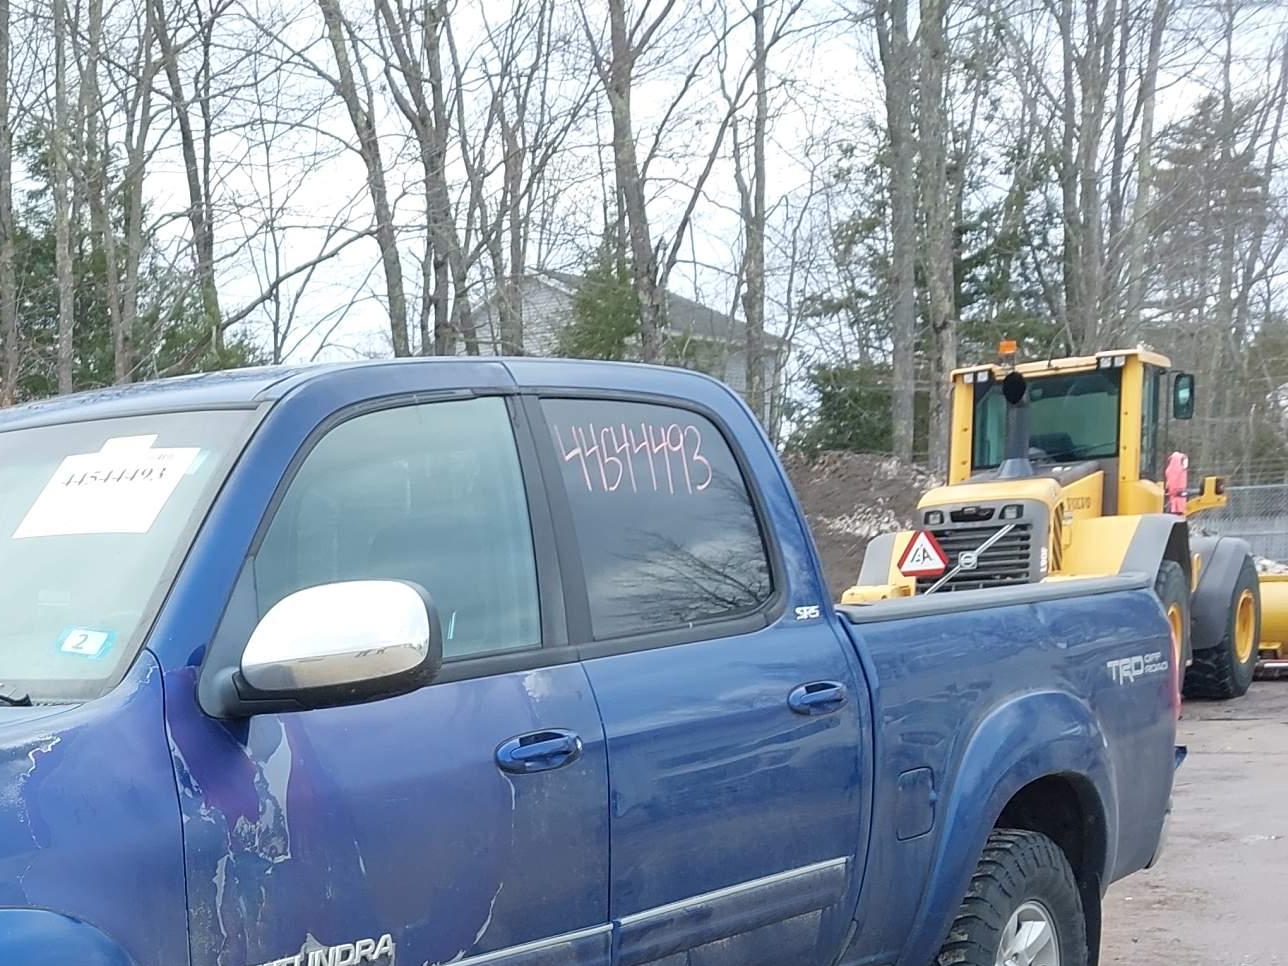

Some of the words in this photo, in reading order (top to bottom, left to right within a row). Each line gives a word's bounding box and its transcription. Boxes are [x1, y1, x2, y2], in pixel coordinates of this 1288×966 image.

[555, 422, 713, 495] 44544493
[71, 633, 89, 650] 2
[1106, 655, 1145, 685] TRD
[1144, 651, 1162, 663] OFF
